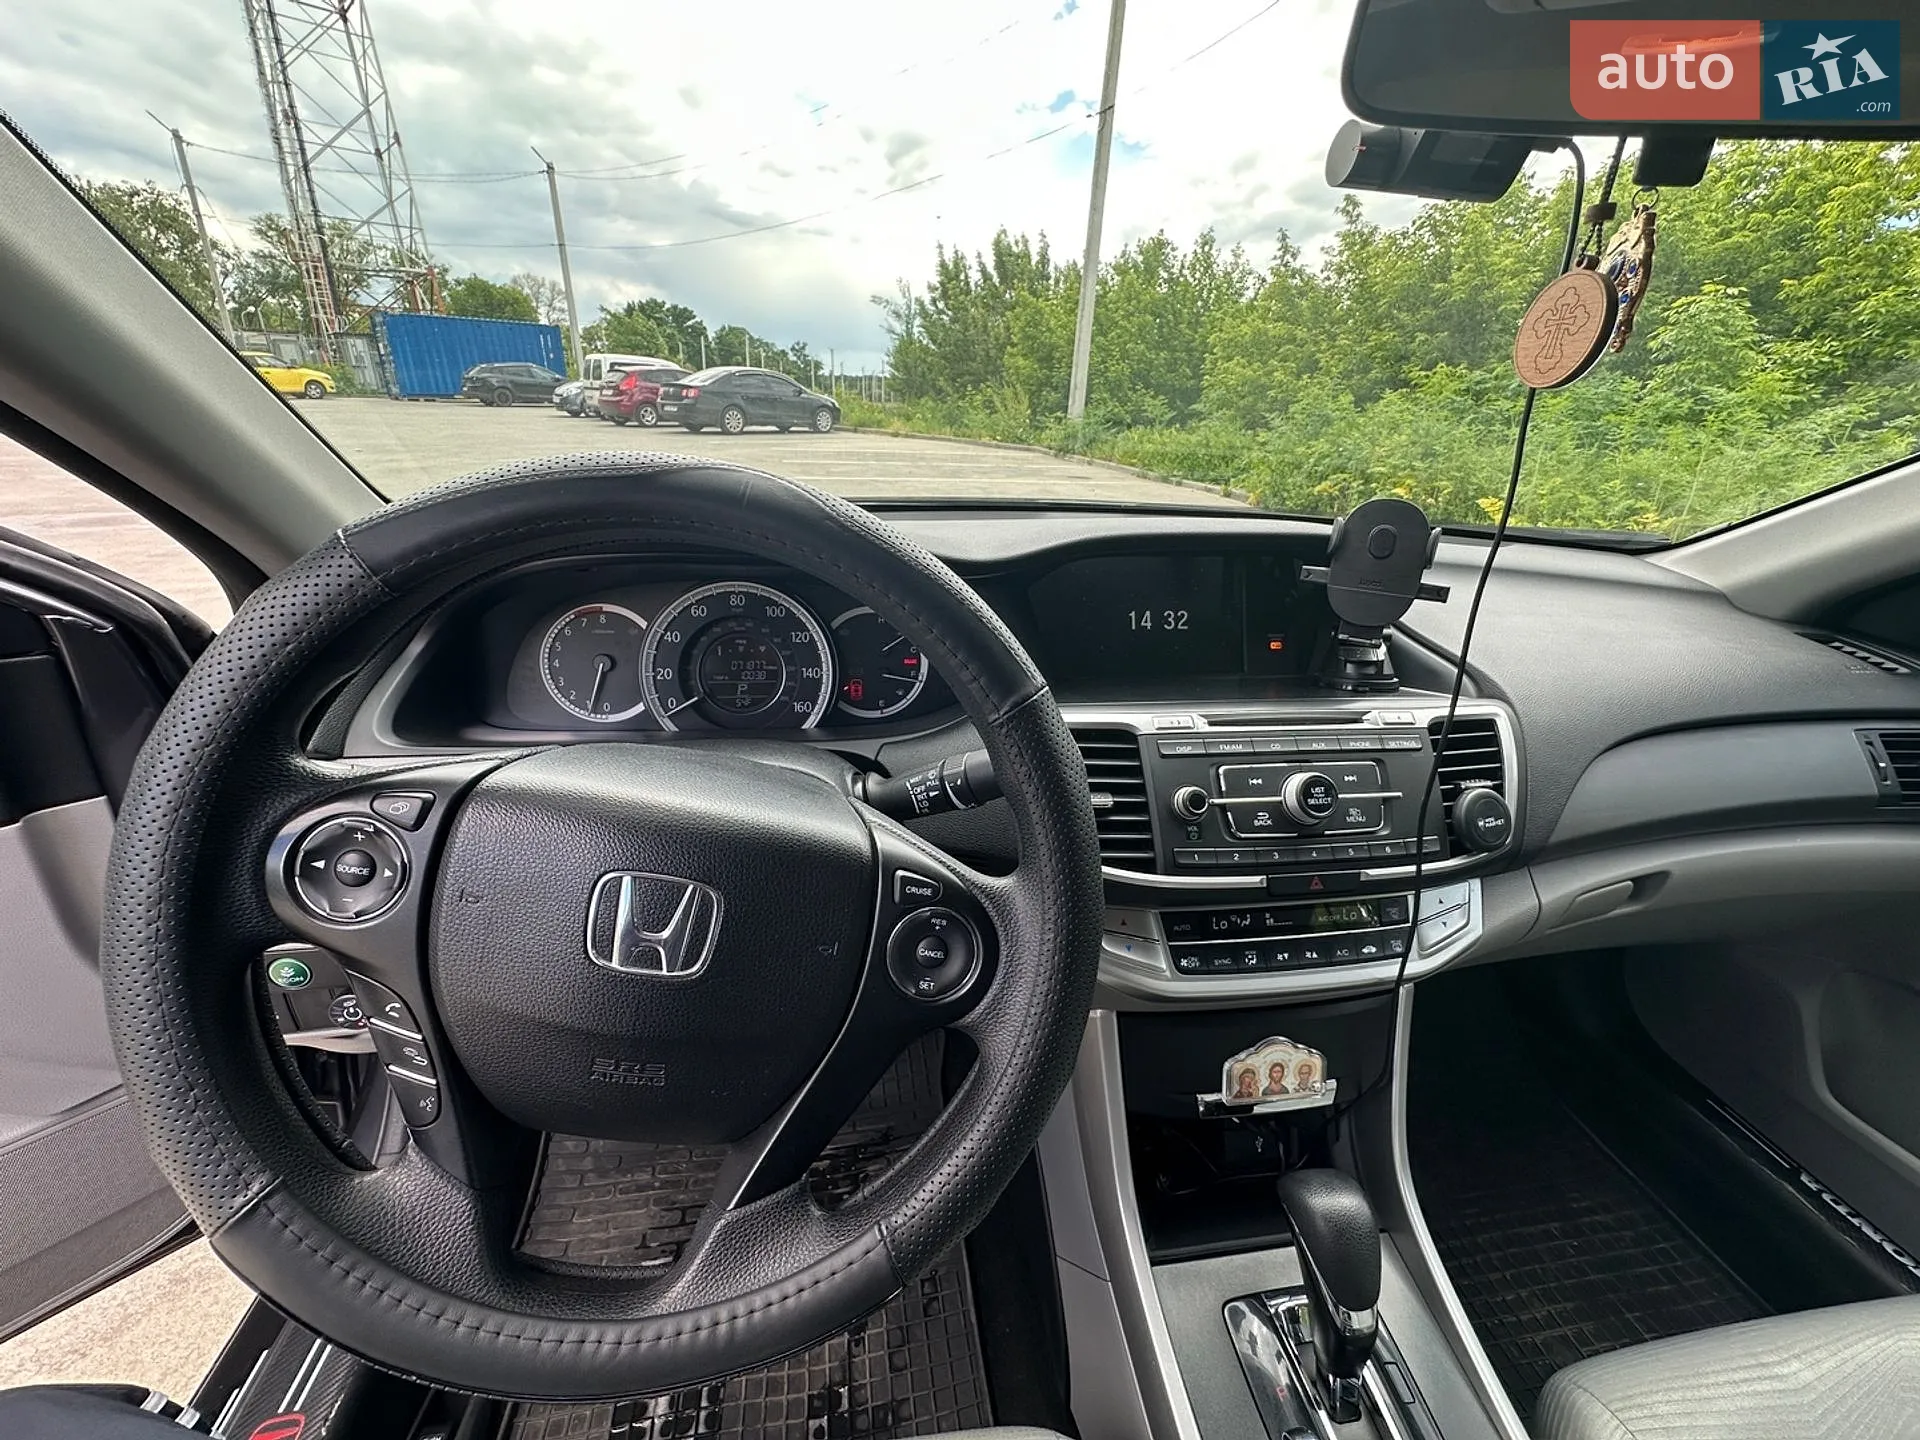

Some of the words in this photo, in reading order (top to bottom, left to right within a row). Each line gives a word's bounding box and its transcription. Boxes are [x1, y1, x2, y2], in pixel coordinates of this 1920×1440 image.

[729, 595, 746, 606] 80
[690, 605, 707, 617] 60
[765, 606, 786, 617] 100
[581, 618, 587, 627] 7
[600, 615, 607, 624] 8
[564, 627, 572, 636] 6
[664, 631, 681, 643] 40
[790, 631, 810, 643] 120
[555, 642, 562, 651] 5
[553, 659, 560, 668] 4
[656, 668, 673, 680] 20
[801, 667, 821, 679] 140
[559, 677, 565, 687] 3
[737, 683, 748, 695] P
[570, 690, 577, 700] 2
[603, 702, 611, 712] 0
[667, 697, 676, 709] 0
[793, 702, 812, 713] 160
[1307, 797, 1332, 805] SELECT
[1253, 819, 1273, 827] BACK
[1233, 853, 1240, 861] 2
[1272, 851, 1279, 860] 3
[336, 863, 371, 876] SOURCE
[905, 885, 933, 896] CRUISE
[931, 917, 947, 926] RES
[918, 948, 945, 959] CANCEL
[918, 980, 935, 990] SET
